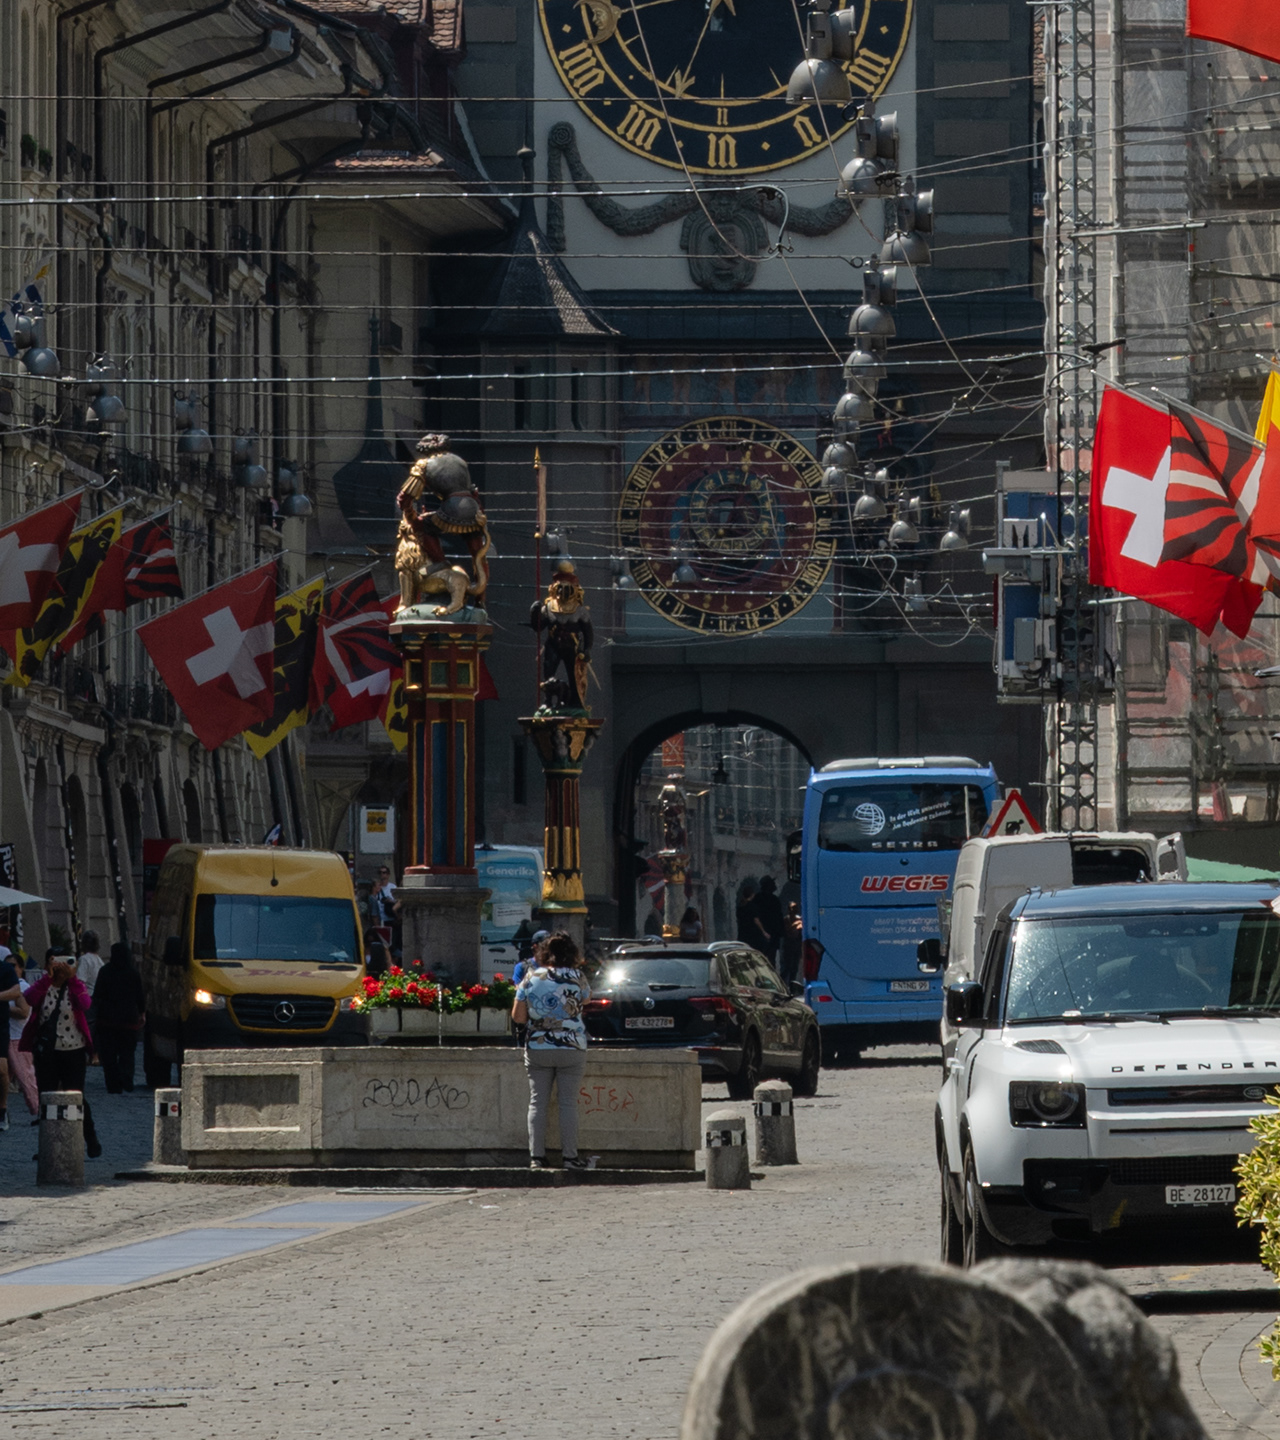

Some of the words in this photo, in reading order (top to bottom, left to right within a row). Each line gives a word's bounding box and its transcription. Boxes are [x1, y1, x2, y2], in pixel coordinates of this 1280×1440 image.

[872, 841, 939, 849] SETRA
[486, 866, 535, 876] Generika
[248, 968, 317, 978] DHL
[1111, 1061, 1277, 1073] DEFENDER
[1171, 1189, 1186, 1202] BE
[1193, 1187, 1231, 1201] 28127
